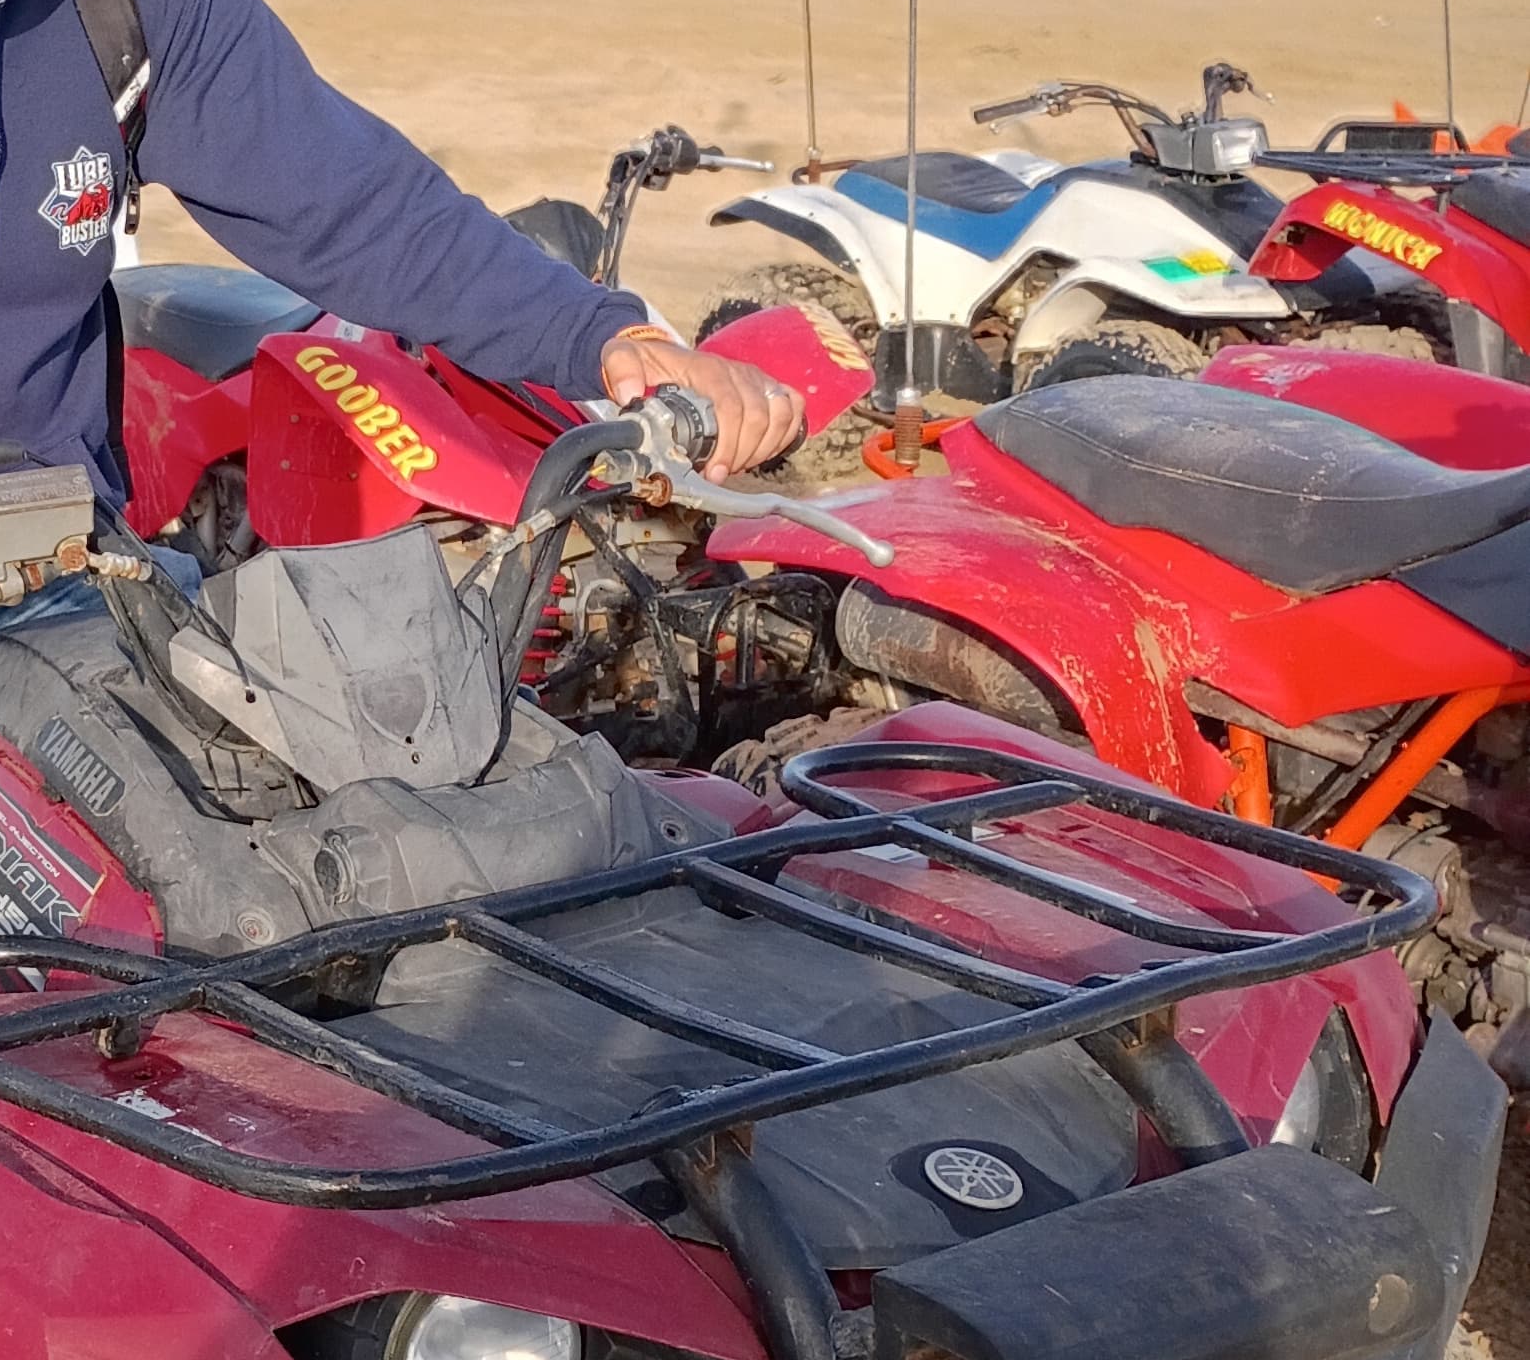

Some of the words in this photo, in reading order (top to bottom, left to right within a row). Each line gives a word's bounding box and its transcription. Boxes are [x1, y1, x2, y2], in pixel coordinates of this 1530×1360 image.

[56, 156, 109, 195] LUBE
[61, 218, 108, 244] BUSTER
[295, 346, 438, 481] GOOBER
[39, 719, 118, 811] YAMAHA
[8, 826, 61, 878] INJECTION
